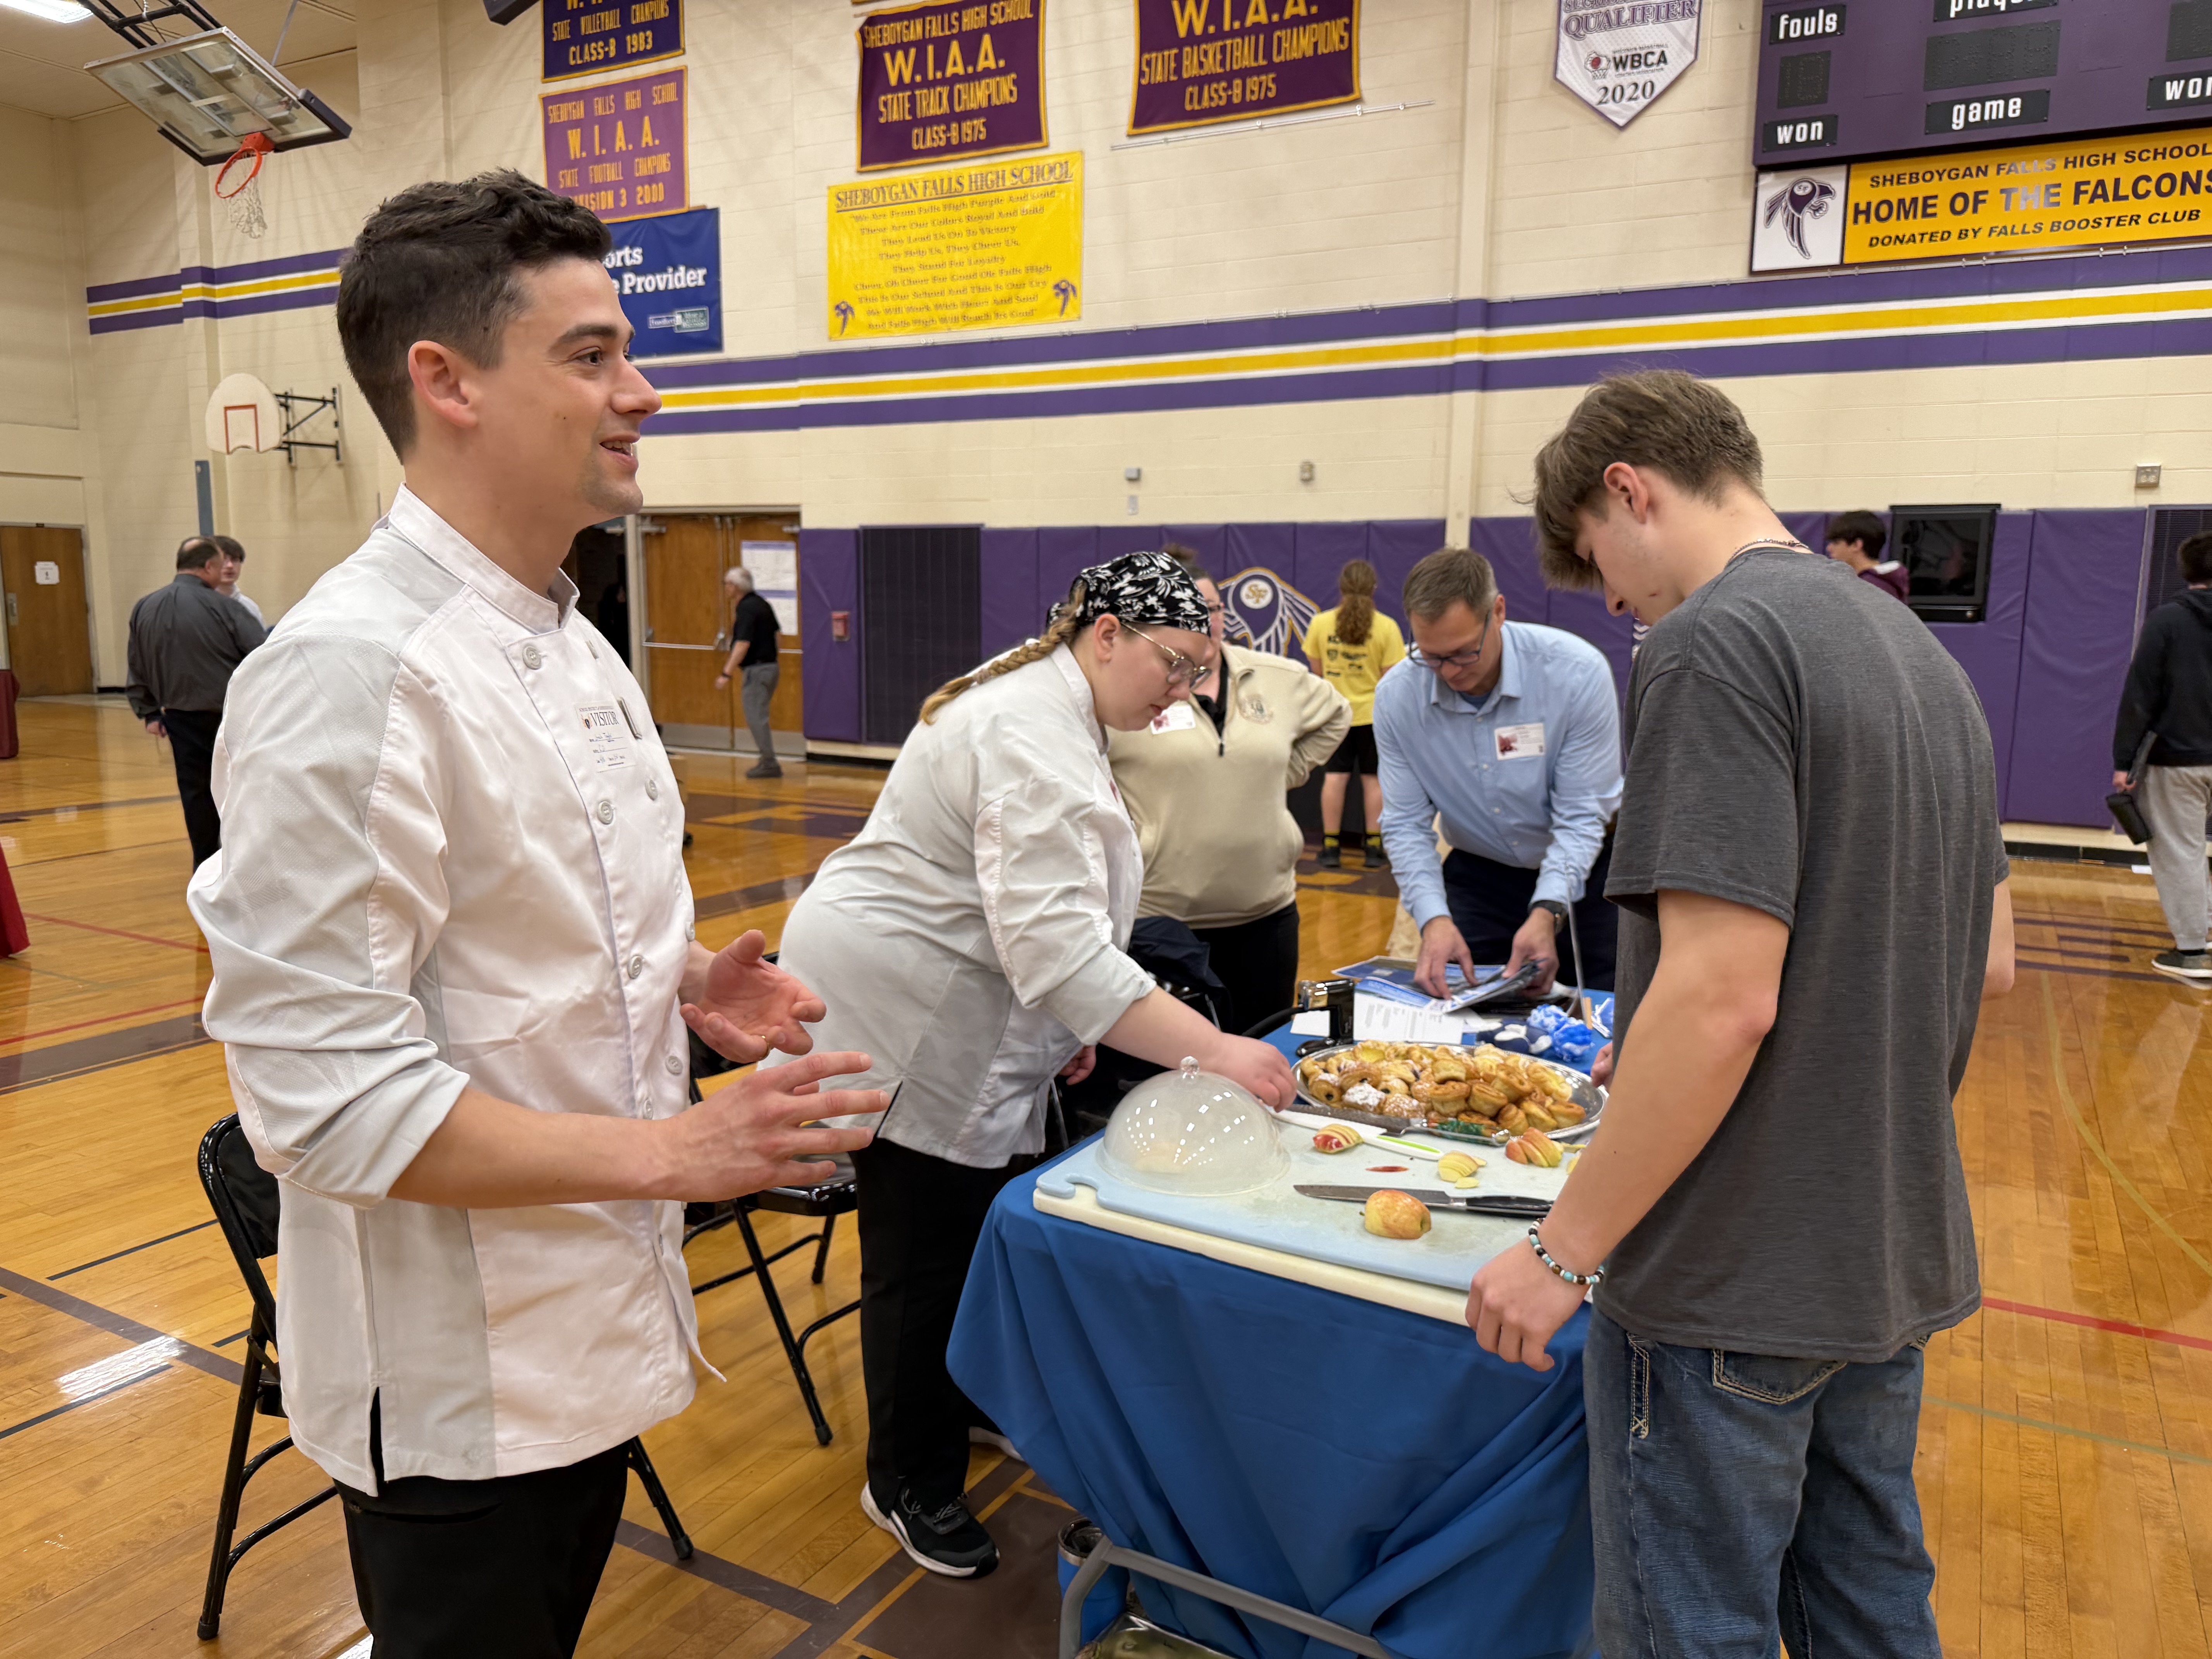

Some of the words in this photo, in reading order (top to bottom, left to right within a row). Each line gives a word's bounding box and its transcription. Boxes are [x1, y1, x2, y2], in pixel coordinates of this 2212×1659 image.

[553, 19, 571, 41] STATE
[580, 8, 621, 35] VOLLEYBALL
[631, 0, 670, 24] CHAMPIONS
[864, 18, 923, 48] SHEBOYGAN
[925, 12, 959, 39] FALLS
[962, 5, 987, 31] HIGH
[989, 0, 1033, 25] SCHOOL
[1562, 0, 1697, 40] QUALIFIER
[1779, 8, 1838, 40] fouls
[569, 38, 616, 65] CLASS-B
[626, 30, 653, 54] 1983
[1140, 48, 1178, 85] STATE
[1182, 33, 1268, 80] BASKETBALL
[1273, 16, 1350, 63] CHAMPIONS
[1613, 50, 1668, 72] WBCA
[594, 94, 615, 116] FALLS
[625, 89, 641, 111] HIGH
[652, 82, 678, 105] SCHOOL
[879, 91, 912, 123] STATE
[915, 86, 950, 118] TRACK
[954, 72, 1017, 113] CHAMPIONS
[1185, 79, 1242, 111] CLASS-B
[1245, 73, 1276, 102] 1975
[1596, 80, 1655, 105] 2020
[1952, 97, 2021, 131] game
[912, 122, 959, 150] CLASS-B
[961, 117, 986, 143] 1975
[1777, 120, 1823, 145] won
[559, 168, 579, 189] STATE
[589, 160, 623, 184] FOOTBALL
[634, 152, 671, 177] CHAMPIONS
[1870, 165, 1989, 188] SHEBOYGAN
[1996, 158, 2056, 177] FALLS
[2064, 153, 2116, 170] HIGH
[2124, 143, 2212, 163] SCHOOL
[569, 190, 614, 212] IVISION
[620, 187, 627, 208] 3
[835, 181, 919, 207] SHEBOYGAN
[923, 174, 964, 197] FALLS
[969, 168, 1006, 191] HIGH
[1010, 161, 1073, 185] SCHOOL
[1853, 195, 1938, 225] HOME
[1949, 190, 1989, 216] OF
[2000, 183, 2061, 212] THE
[1869, 230, 1951, 248] DONATED
[1958, 226, 1982, 240] BY
[1988, 222, 2044, 238] FALLS
[2049, 214, 2142, 233] BOOSTER
[2148, 209, 2201, 224] CLUB
[602, 246, 643, 269] orts
[622, 264, 707, 294] Provider
[590, 711, 619, 726] VISITOR
